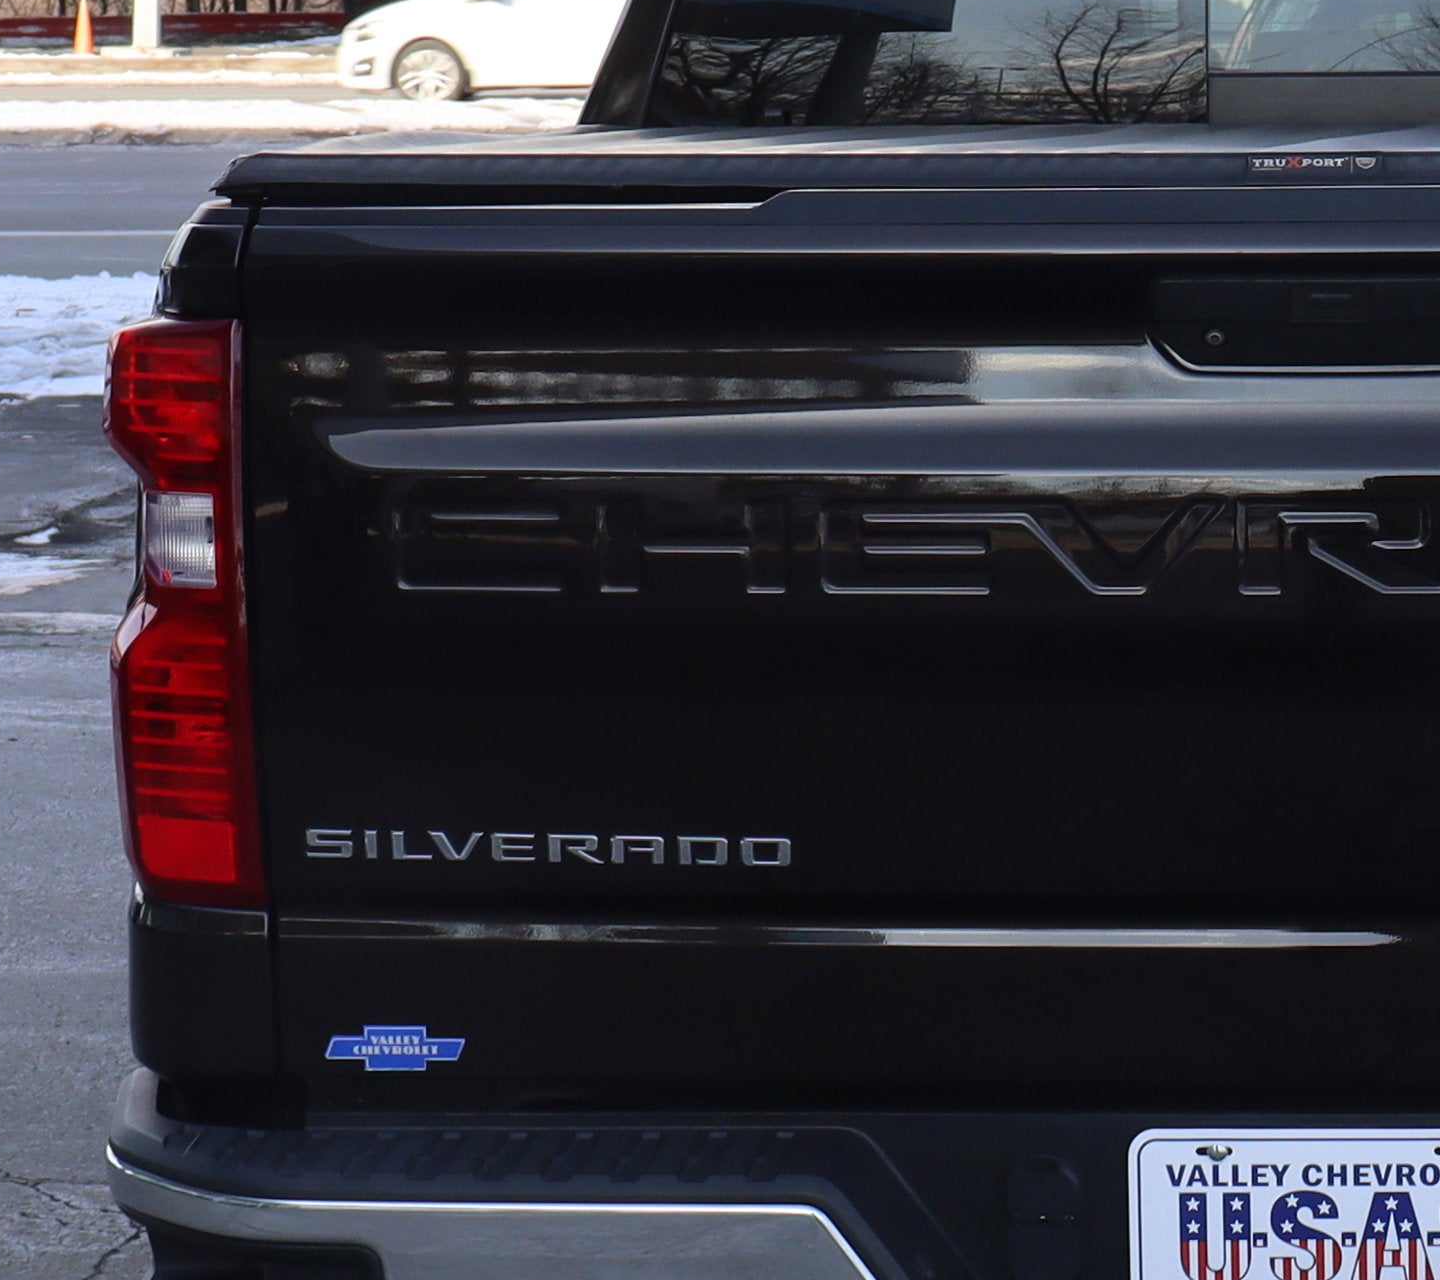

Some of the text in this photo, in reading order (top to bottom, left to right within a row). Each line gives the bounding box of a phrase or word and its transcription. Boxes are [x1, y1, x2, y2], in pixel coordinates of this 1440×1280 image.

[305, 828, 792, 867] SILVERADO
[369, 1035, 421, 1045] VALLEY
[352, 1045, 439, 1056] CHEVROLET
[1165, 1163, 1291, 1187] VALLEY
